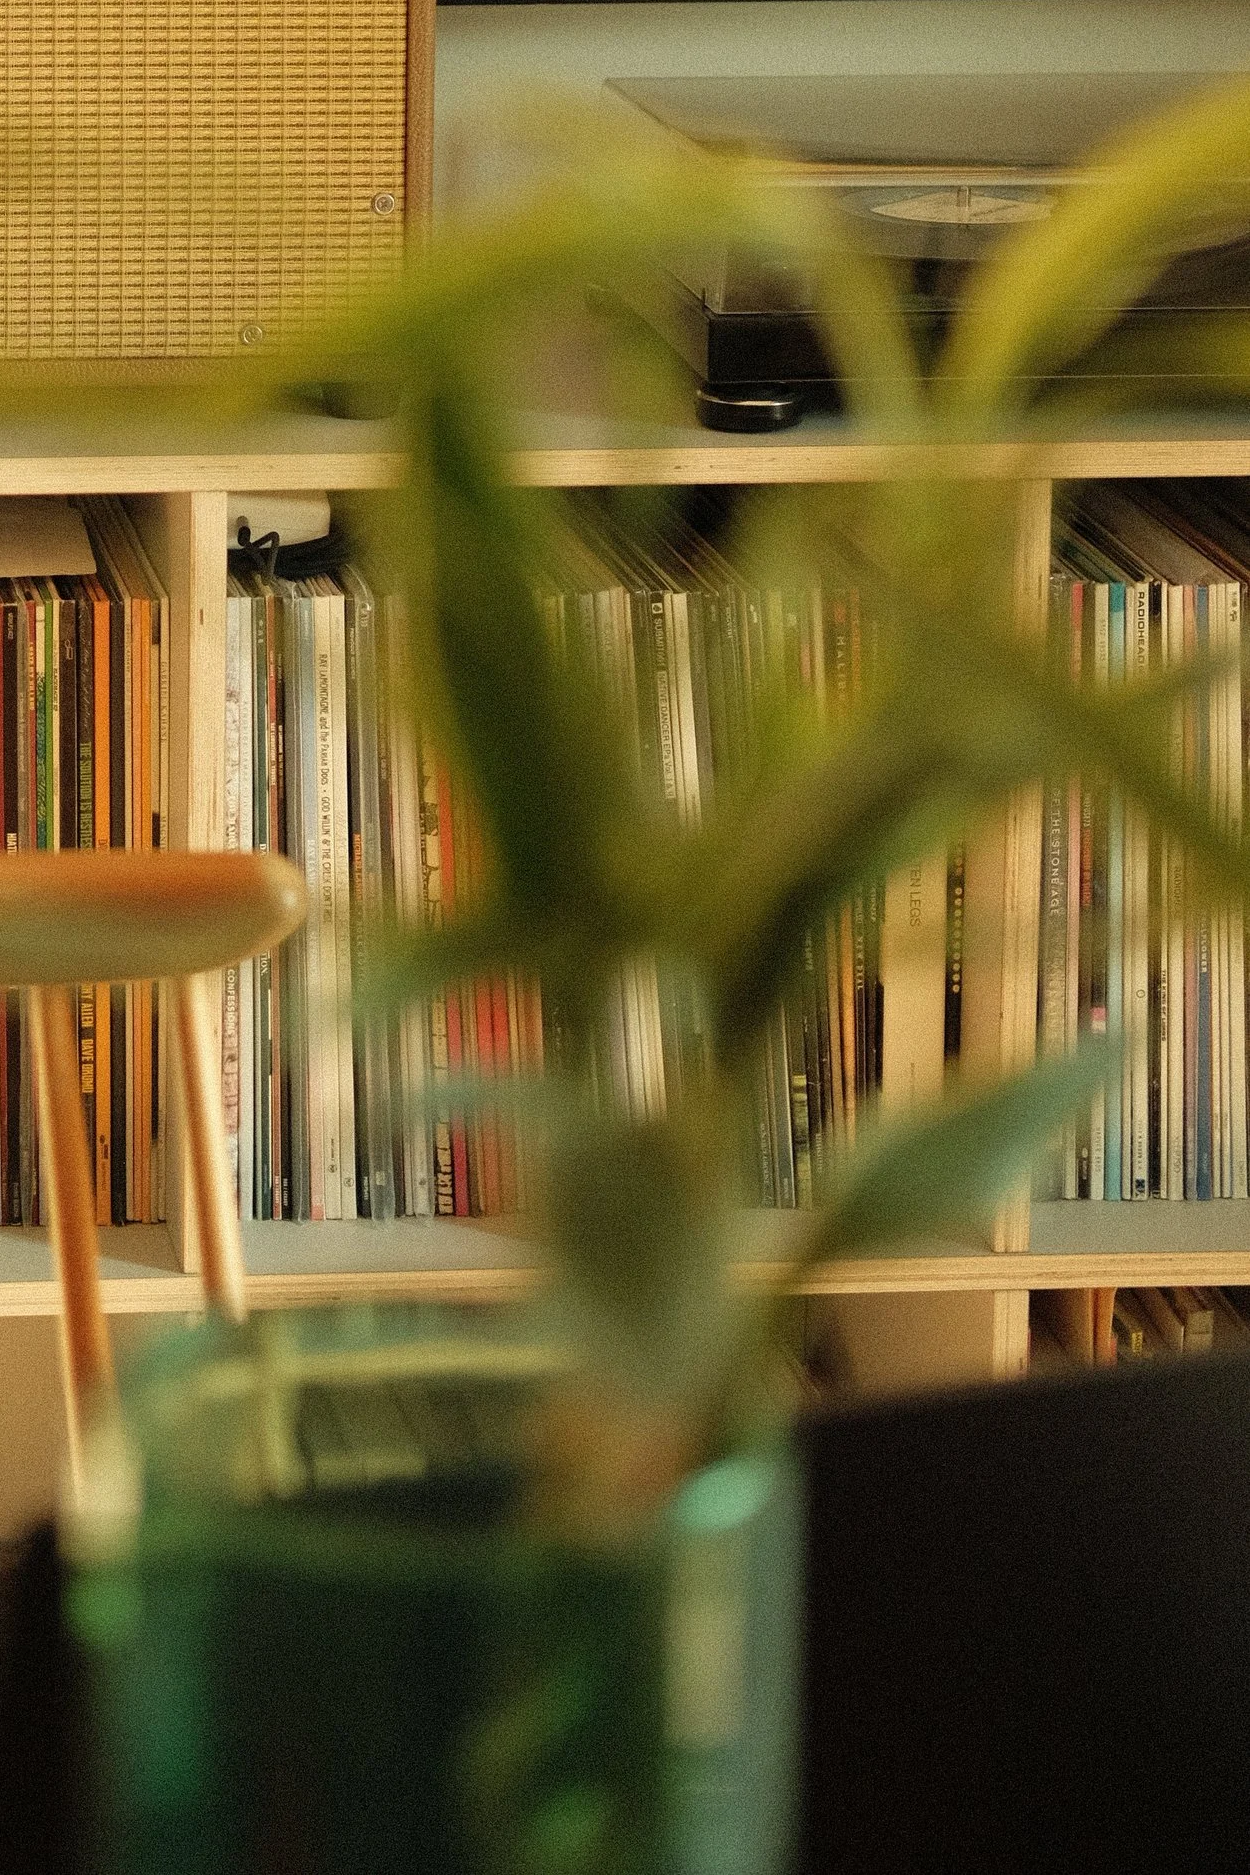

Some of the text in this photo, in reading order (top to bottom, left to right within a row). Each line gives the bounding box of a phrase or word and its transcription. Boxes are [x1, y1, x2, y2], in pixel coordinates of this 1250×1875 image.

[1137, 591, 1146, 664] RADIOHEAD
[318, 654, 328, 667] RAY
[657, 672, 668, 705] NATIVE
[319, 717, 329, 730] and
[660, 706, 670, 742] DANCER
[79, 741, 92, 758] THE
[662, 743, 672, 760] EPs
[80, 759, 93, 800] SOLUTION
[80, 802, 93, 810] IS
[321, 796, 331, 813] GOD
[80, 812, 94, 848] RESTLES
[321, 815, 331, 836] WILLIN'
[1050, 810, 1061, 834] THE
[322, 848, 331, 860] THE
[353, 833, 362, 871] MICHAEL
[1050, 840, 1061, 884] STONE
[322, 862, 332, 884] CREEK
[323, 886, 332, 907] DON'T
[1050, 890, 1061, 916] AGE
[910, 891, 922, 928] LEGS
[227, 969, 236, 1034] CONFESSIONS
[81, 1003, 94, 1028] ALLEN
[81, 1038, 94, 1062] DAVE
